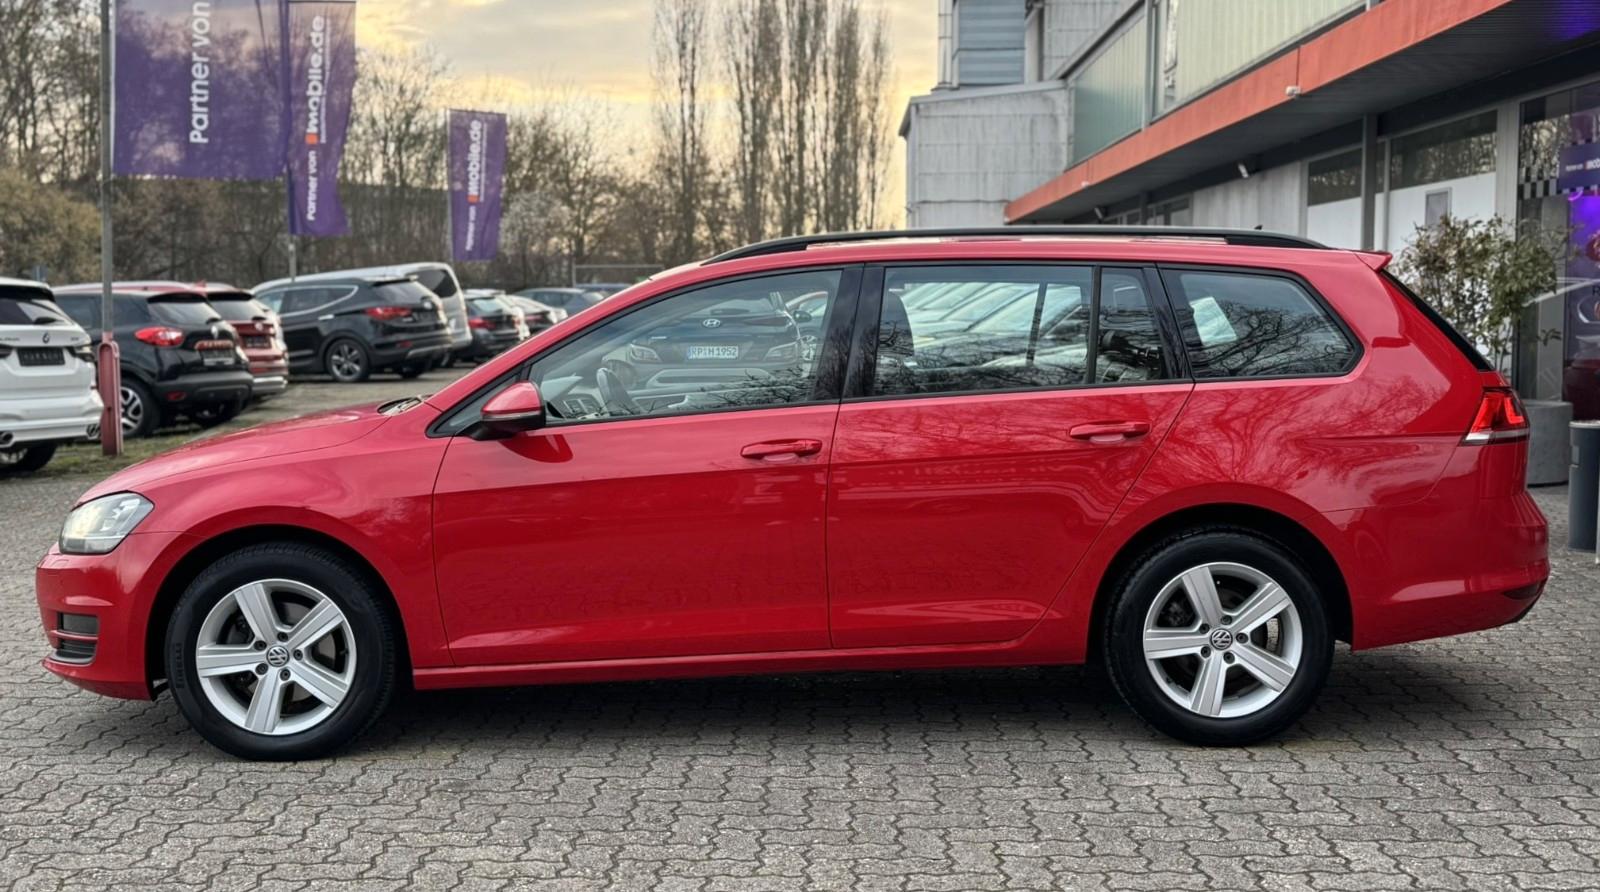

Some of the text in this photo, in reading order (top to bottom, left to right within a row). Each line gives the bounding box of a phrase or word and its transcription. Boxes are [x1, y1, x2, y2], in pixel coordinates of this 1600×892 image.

[189, 1, 210, 143] Partner von
[305, 15, 325, 133] mobile.de
[467, 120, 481, 195] mobile.de
